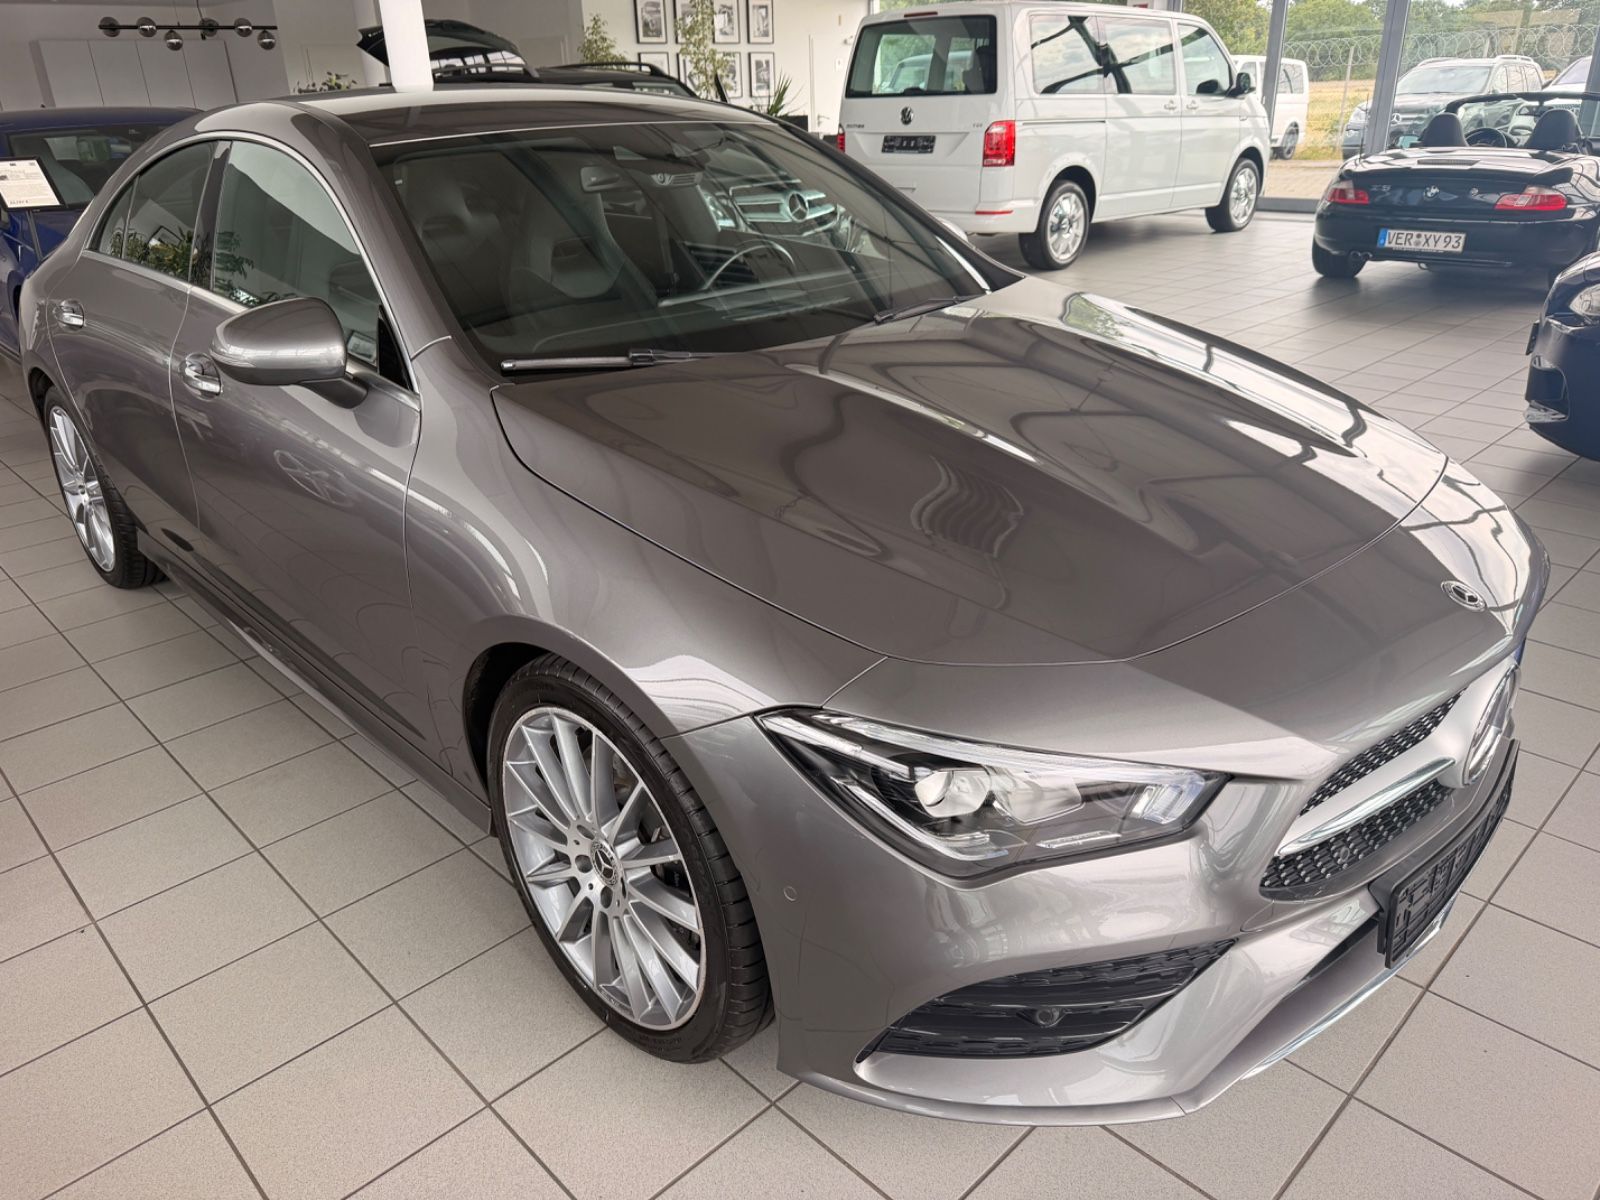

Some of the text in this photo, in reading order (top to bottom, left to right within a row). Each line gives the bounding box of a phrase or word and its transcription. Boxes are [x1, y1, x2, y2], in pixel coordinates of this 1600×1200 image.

[1388, 231, 1462, 249] VER XY 93
